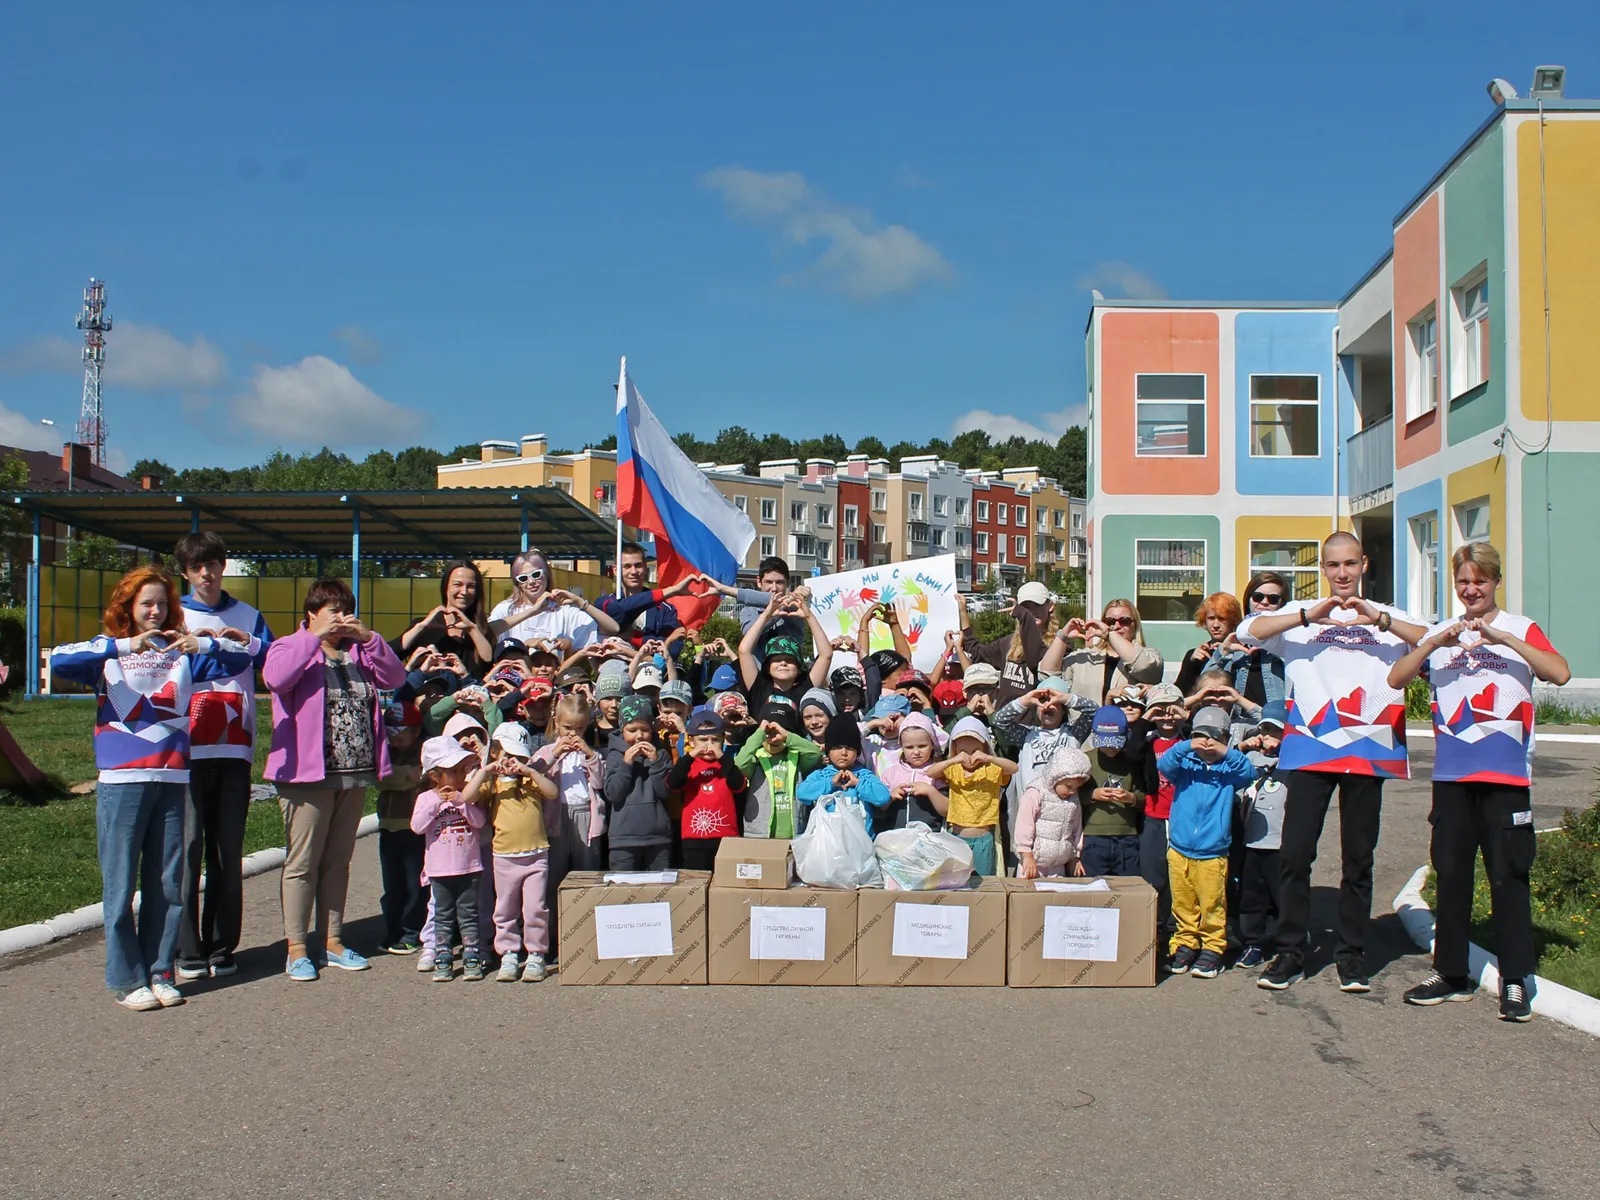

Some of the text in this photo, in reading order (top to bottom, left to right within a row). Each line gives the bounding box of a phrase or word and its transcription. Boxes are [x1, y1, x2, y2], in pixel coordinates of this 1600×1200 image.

[121, 660, 182, 671] ОДМОСКОВЬЯ
[1443, 661, 1508, 671] ПОДМОСКОВЬЯ
[561, 908, 595, 942] WILDBERRIES
[605, 922, 636, 930] ПРОДУКТЫ
[910, 922, 952, 930] МЕДИЦИНСКИЕ
[665, 940, 700, 974] WILDBERRIES
